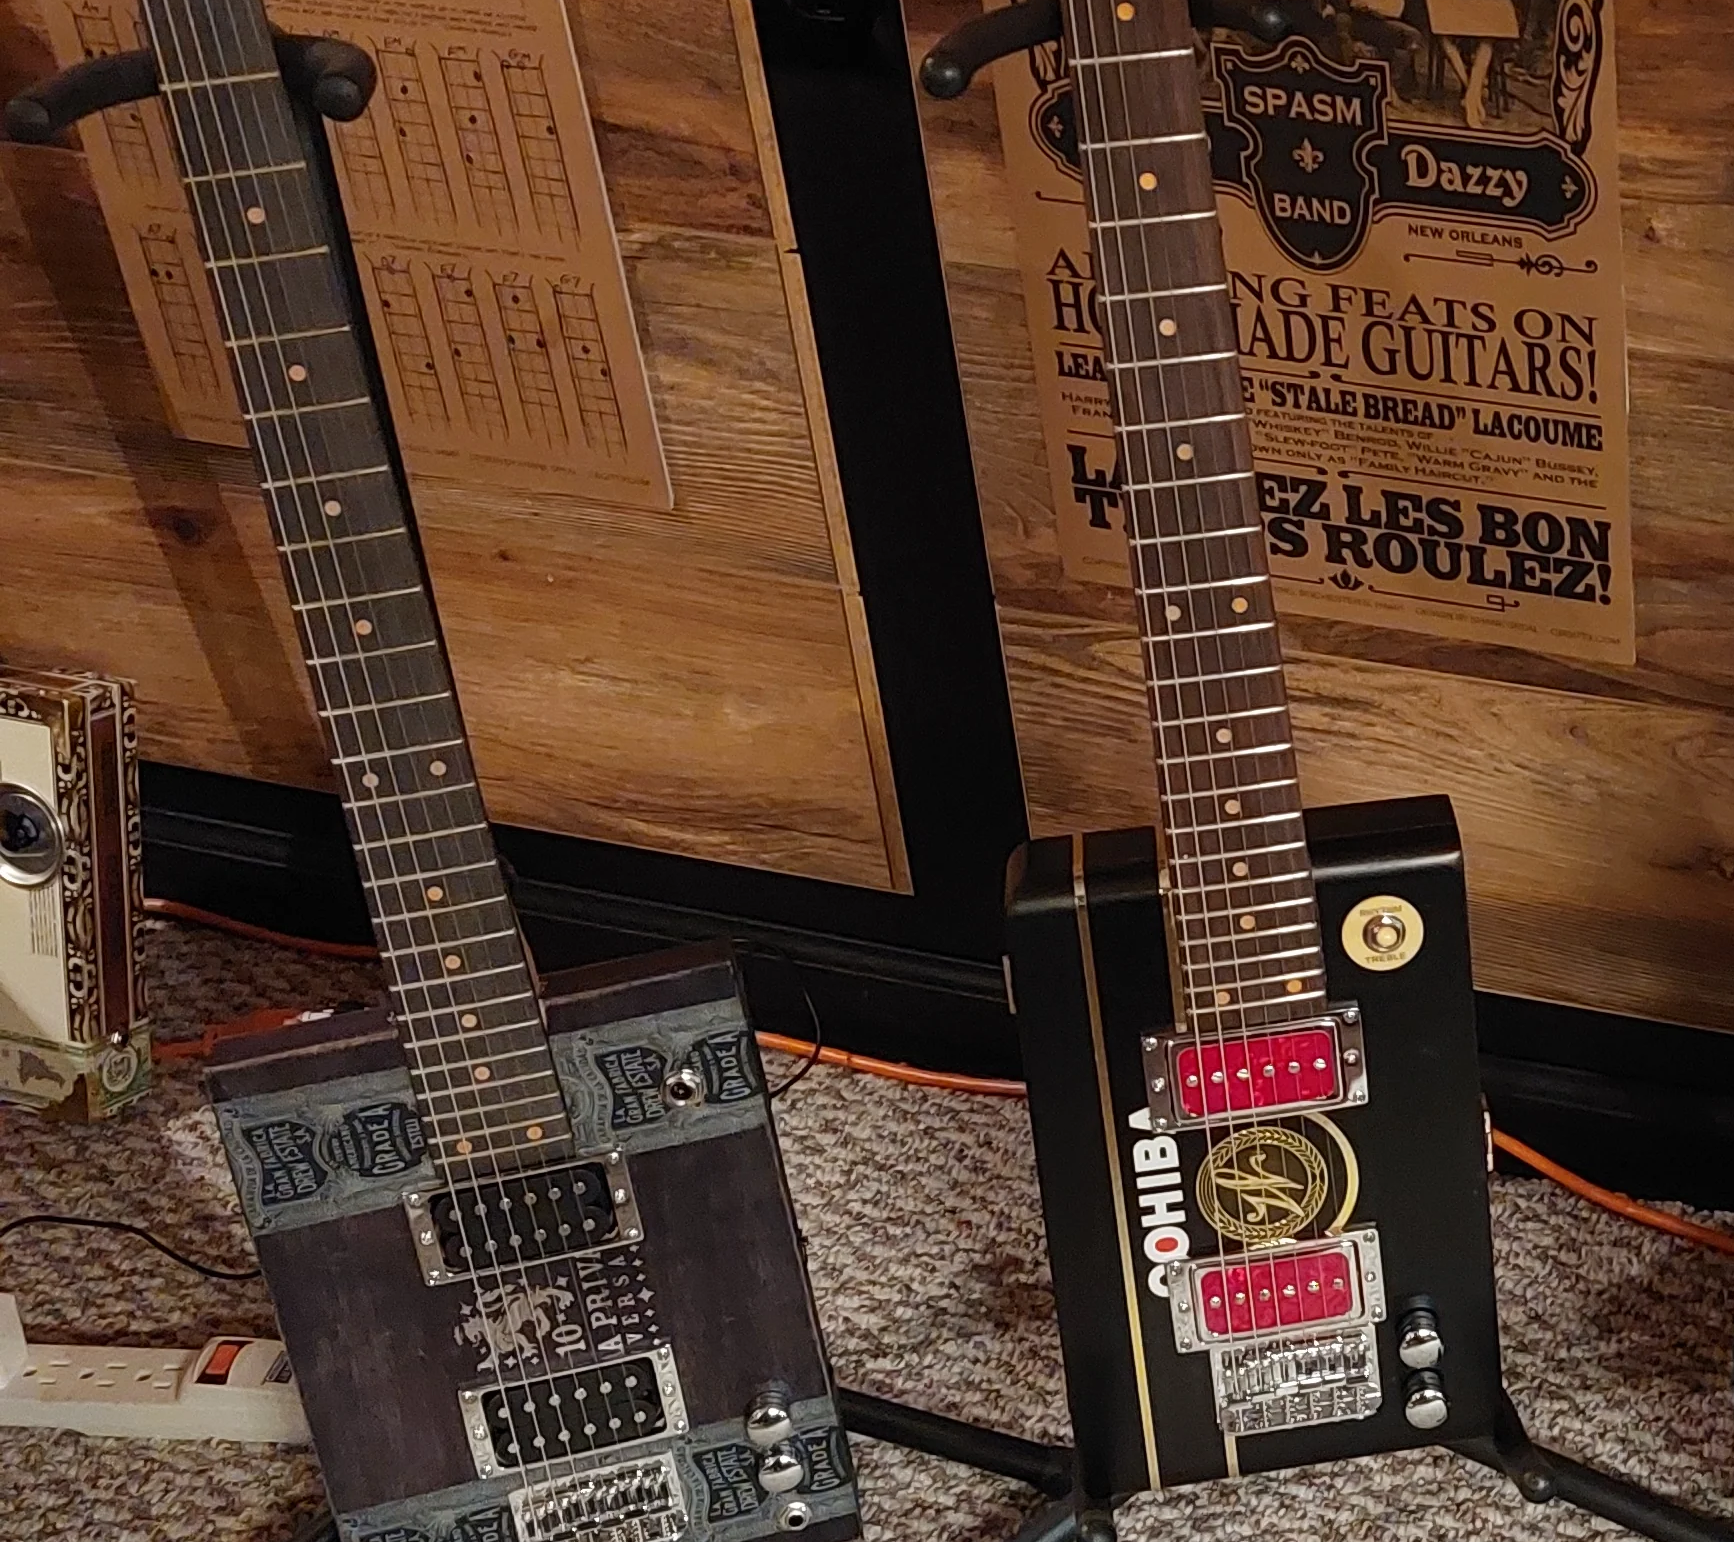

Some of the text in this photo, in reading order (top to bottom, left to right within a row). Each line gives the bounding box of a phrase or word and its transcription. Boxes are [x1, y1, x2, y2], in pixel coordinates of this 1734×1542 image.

[1243, 85, 1364, 126] SPASM
[1401, 143, 1529, 209] Dazzy
[1274, 191, 1353, 227] BAND
[1408, 223, 1523, 250] NEW ORLEANS
[1326, 282, 1599, 348] FEATS ON
[1361, 320, 1599, 405] GUITARS!
[1256, 408, 1328, 426] FEATURING
[1329, 417, 1357, 431] THE
[1358, 421, 1415, 438] TALENTS
[1259, 378, 1358, 418] "STALE
[1361, 392, 1467, 431] BREAD"
[1471, 408, 1604, 452] LACOUME
[1285, 448, 1323, 462] ONLY
[1327, 455, 1346, 466] AS
[1532, 472, 1566, 485] AND
[1568, 475, 1599, 489] THE
[1342, 483, 1465, 542] LES
[1475, 502, 1612, 563] BON
[1325, 522, 1613, 606] ROULEZ!
[622, 1048, 653, 1088] ESTATE
[716, 1045, 751, 1101] GRADE
[269, 1122, 318, 1194] DREW ESTATE
[368, 1118, 406, 1175] GRADE
[551, 1324, 587, 1358] 10
[807, 1439, 841, 1491] GRADE
